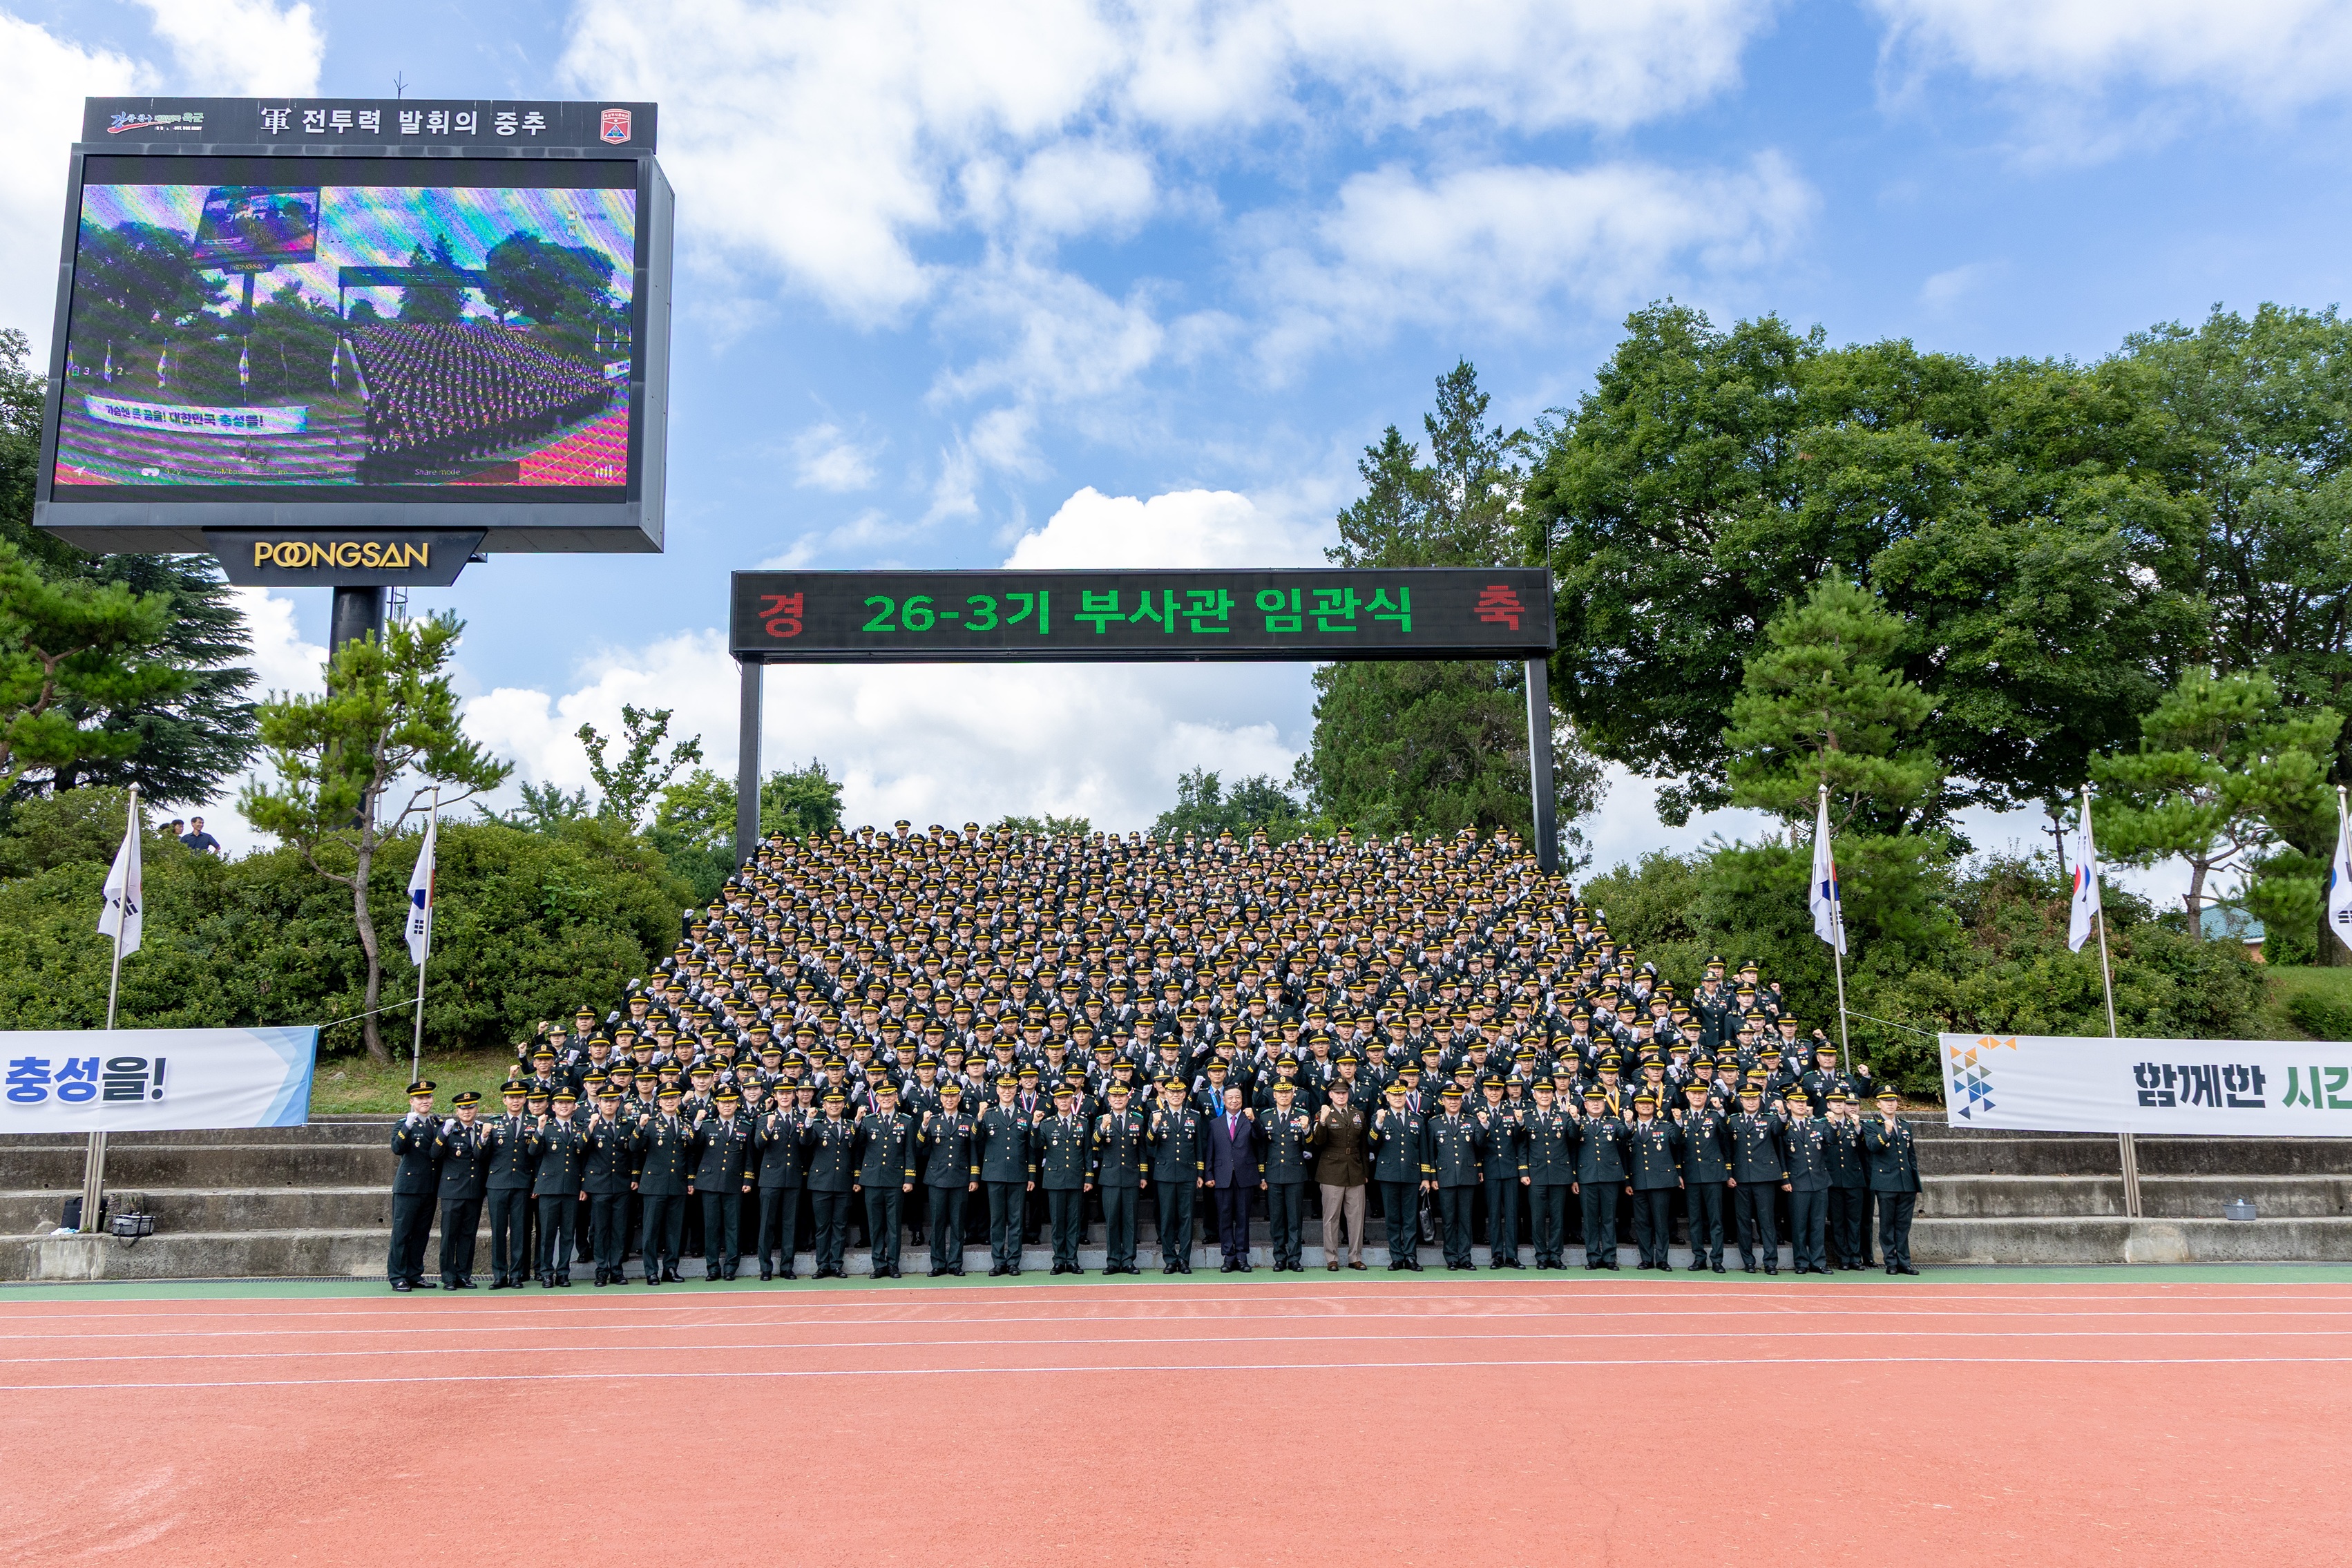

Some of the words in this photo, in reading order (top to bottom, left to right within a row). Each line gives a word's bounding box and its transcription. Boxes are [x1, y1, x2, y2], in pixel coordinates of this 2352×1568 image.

[260, 107, 291, 135] 軍
[302, 109, 381, 134] 전투력
[399, 110, 477, 135] 발휘의
[494, 111, 546, 136] 중추
[169, 412, 216, 426] 대한민국
[219, 414, 263, 427] 충성을!
[254, 542, 429, 568] POONGSAN
[758, 592, 804, 638] 경
[861, 591, 1050, 635] 26-3기
[1074, 589, 1236, 634] 부사관
[1255, 586, 1413, 633] 임관식
[1473, 585, 1525, 631] 축
[5, 1055, 167, 1102] 충성을!
[2132, 1062, 2267, 1109] 함께한
